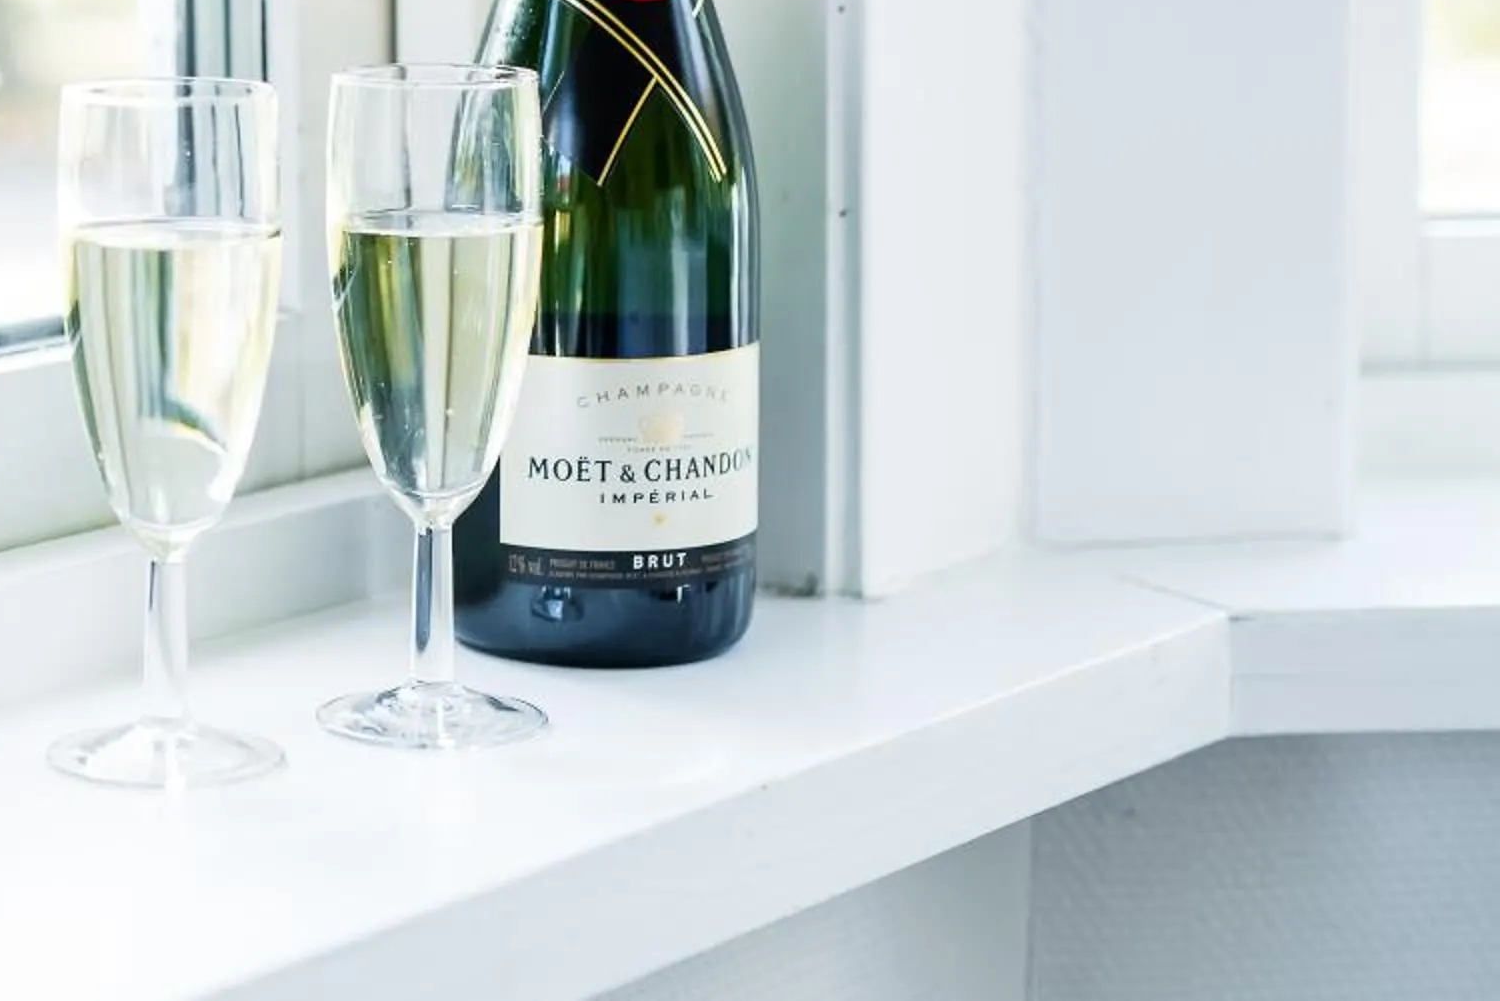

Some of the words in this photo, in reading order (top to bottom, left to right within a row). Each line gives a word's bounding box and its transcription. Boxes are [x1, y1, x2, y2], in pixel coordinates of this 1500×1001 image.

[579, 384, 726, 408] CHAMPAGNE
[528, 456, 612, 482] MOËT
[620, 465, 637, 482] &
[600, 489, 713, 504] IMPÉRIAL
[632, 552, 687, 570] BRUT
